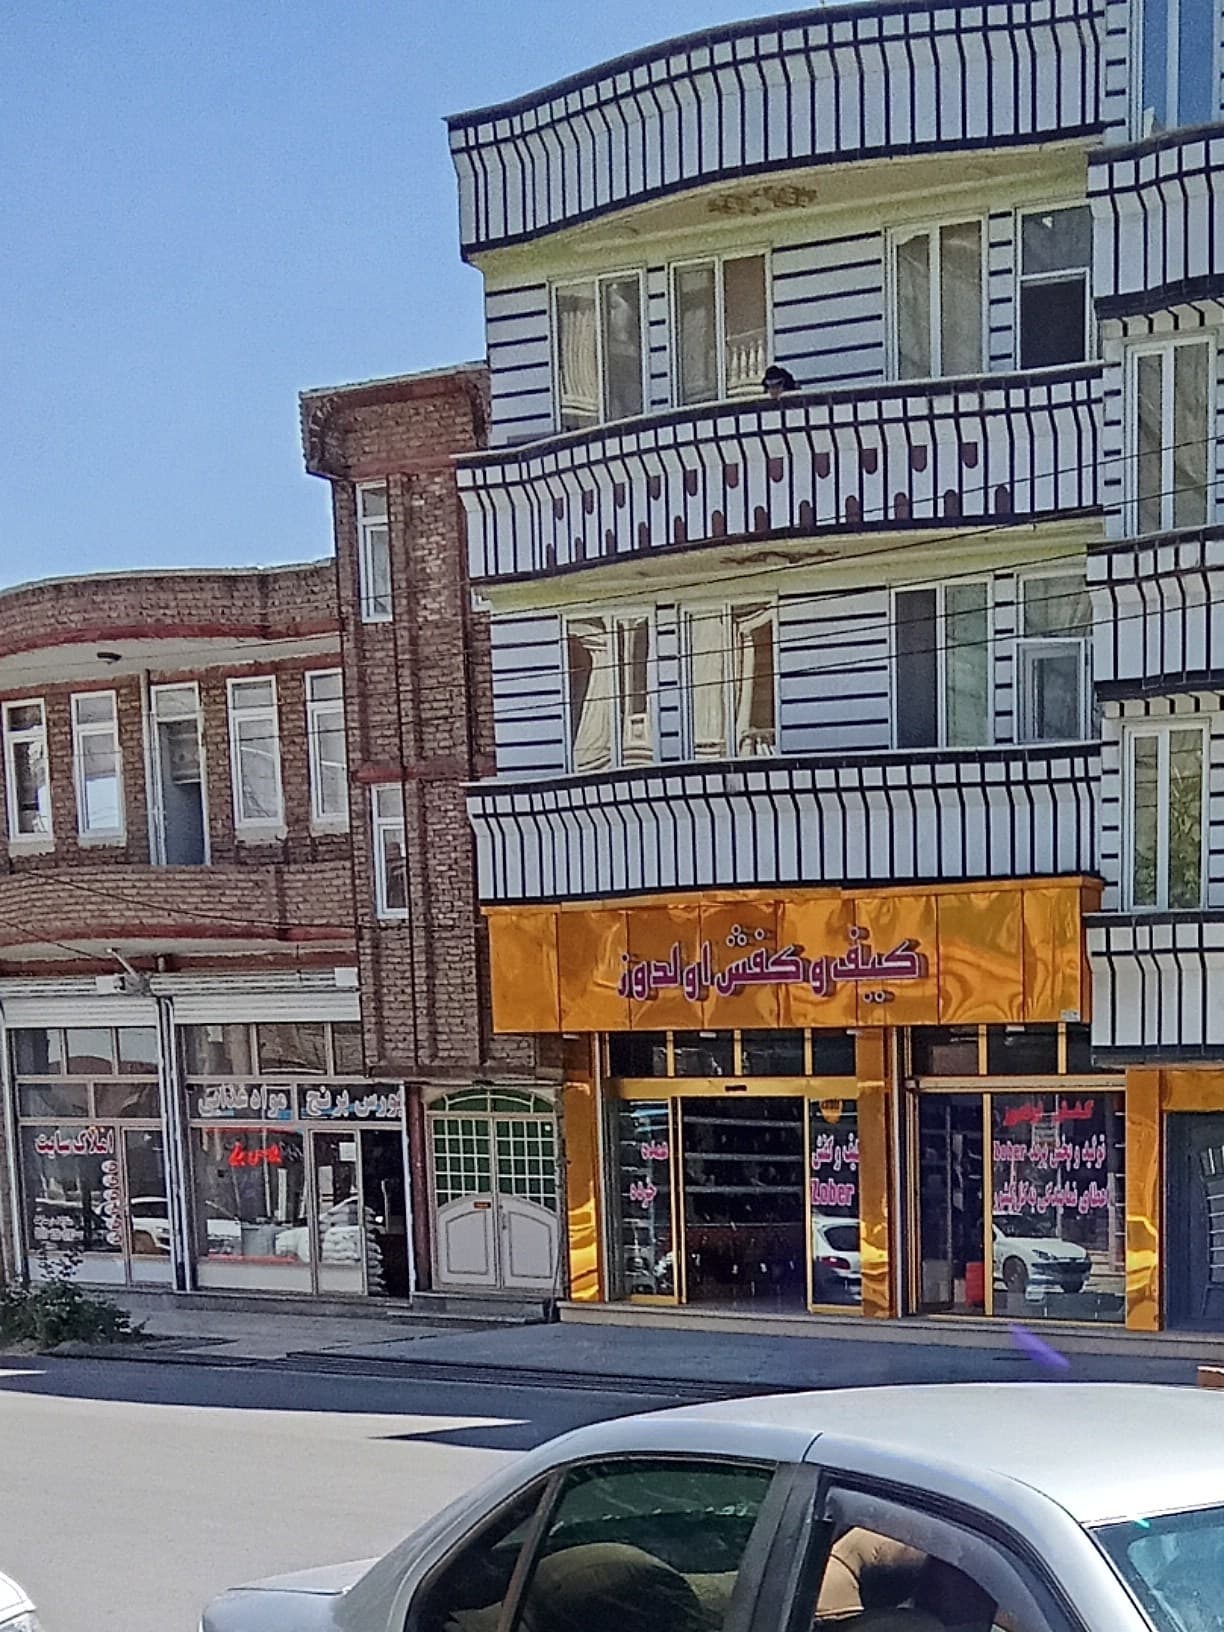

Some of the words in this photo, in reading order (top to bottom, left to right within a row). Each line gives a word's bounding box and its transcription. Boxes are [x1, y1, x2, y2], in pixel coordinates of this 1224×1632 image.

[616, 940, 712, 1001] اولدوز
[713, 923, 804, 998] کفش
[809, 955, 828, 997] و
[830, 926, 922, 1003] کیف
[306, 1085, 349, 1118] برنج
[811, 1133, 834, 1171] کفش
[832, 1145, 842, 1171] و
[1081, 1133, 1106, 1169] تولید
[811, 1177, 855, 1206] Zober
